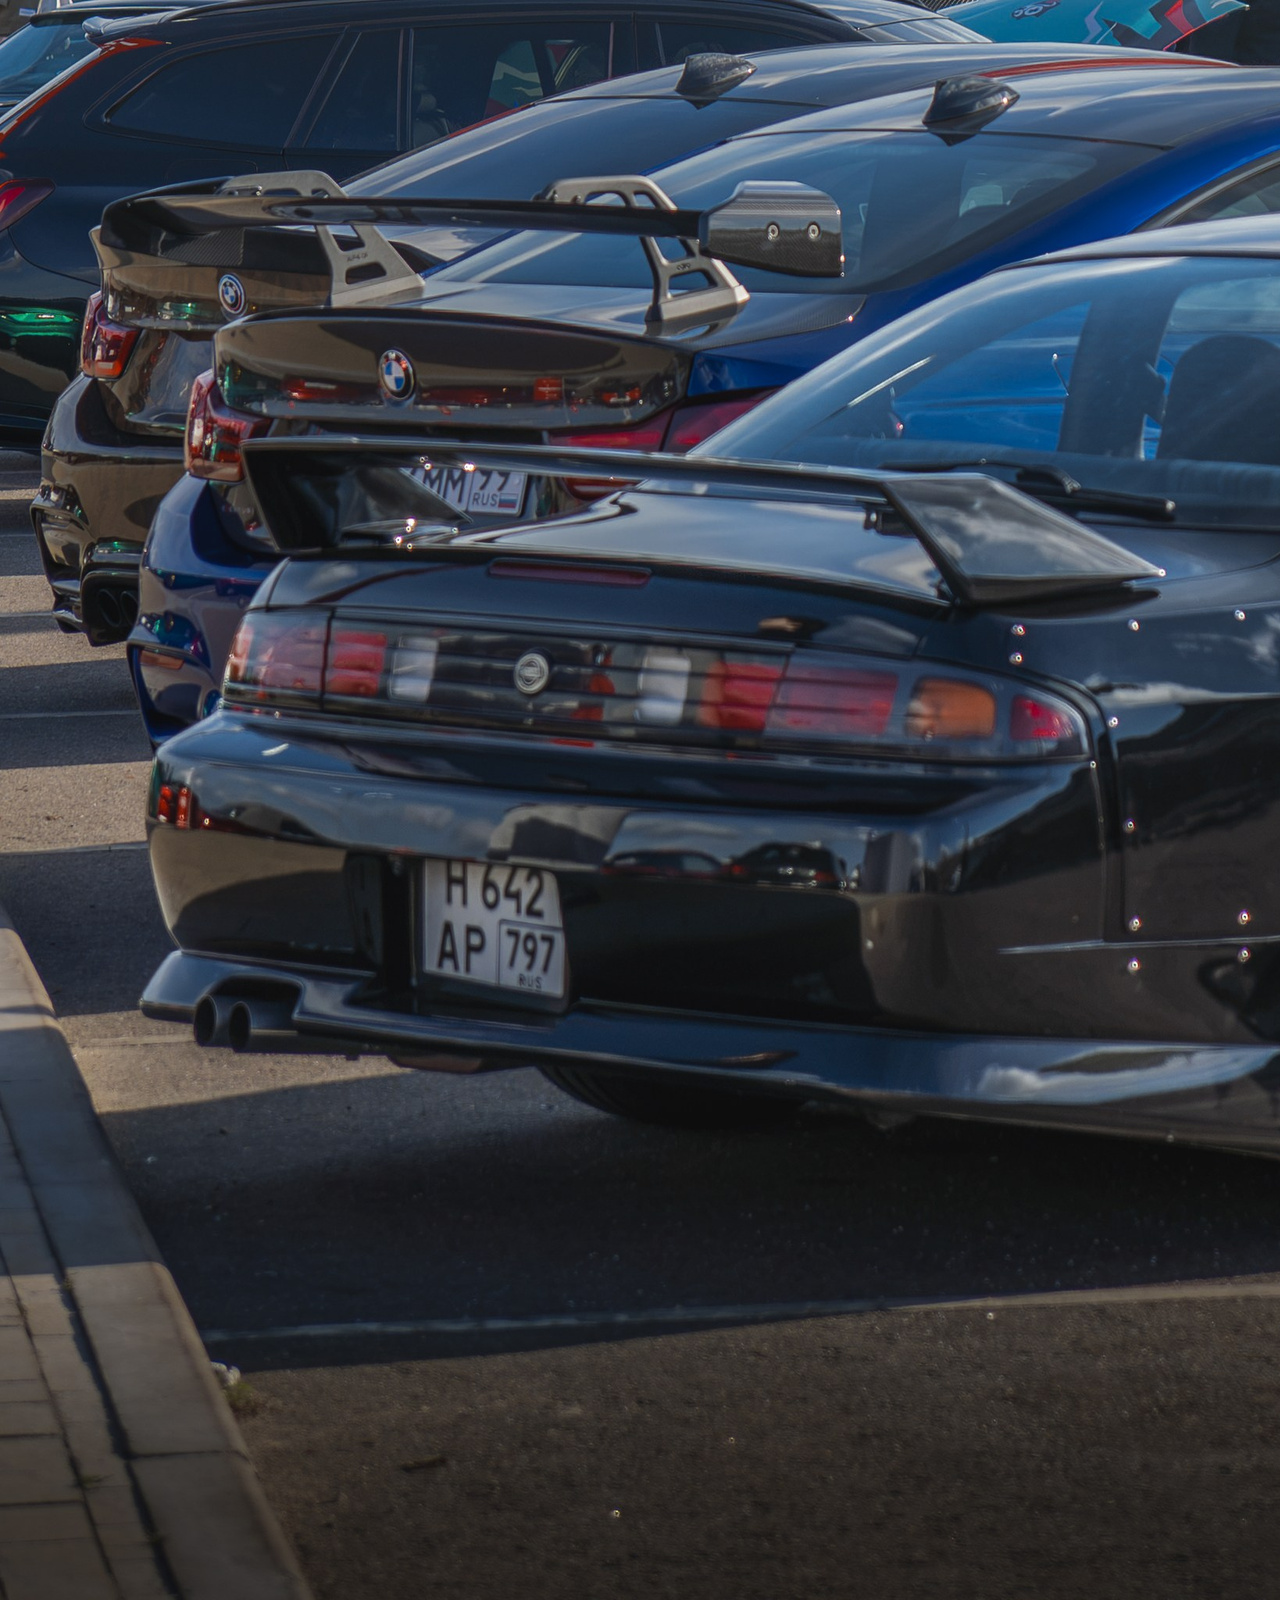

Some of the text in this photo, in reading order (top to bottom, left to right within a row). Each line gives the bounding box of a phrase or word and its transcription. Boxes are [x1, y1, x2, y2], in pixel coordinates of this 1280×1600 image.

[472, 492, 498, 507] RUS
[482, 862, 544, 919] 642
[437, 919, 555, 974] АР 797
[518, 972, 542, 990] RUS
